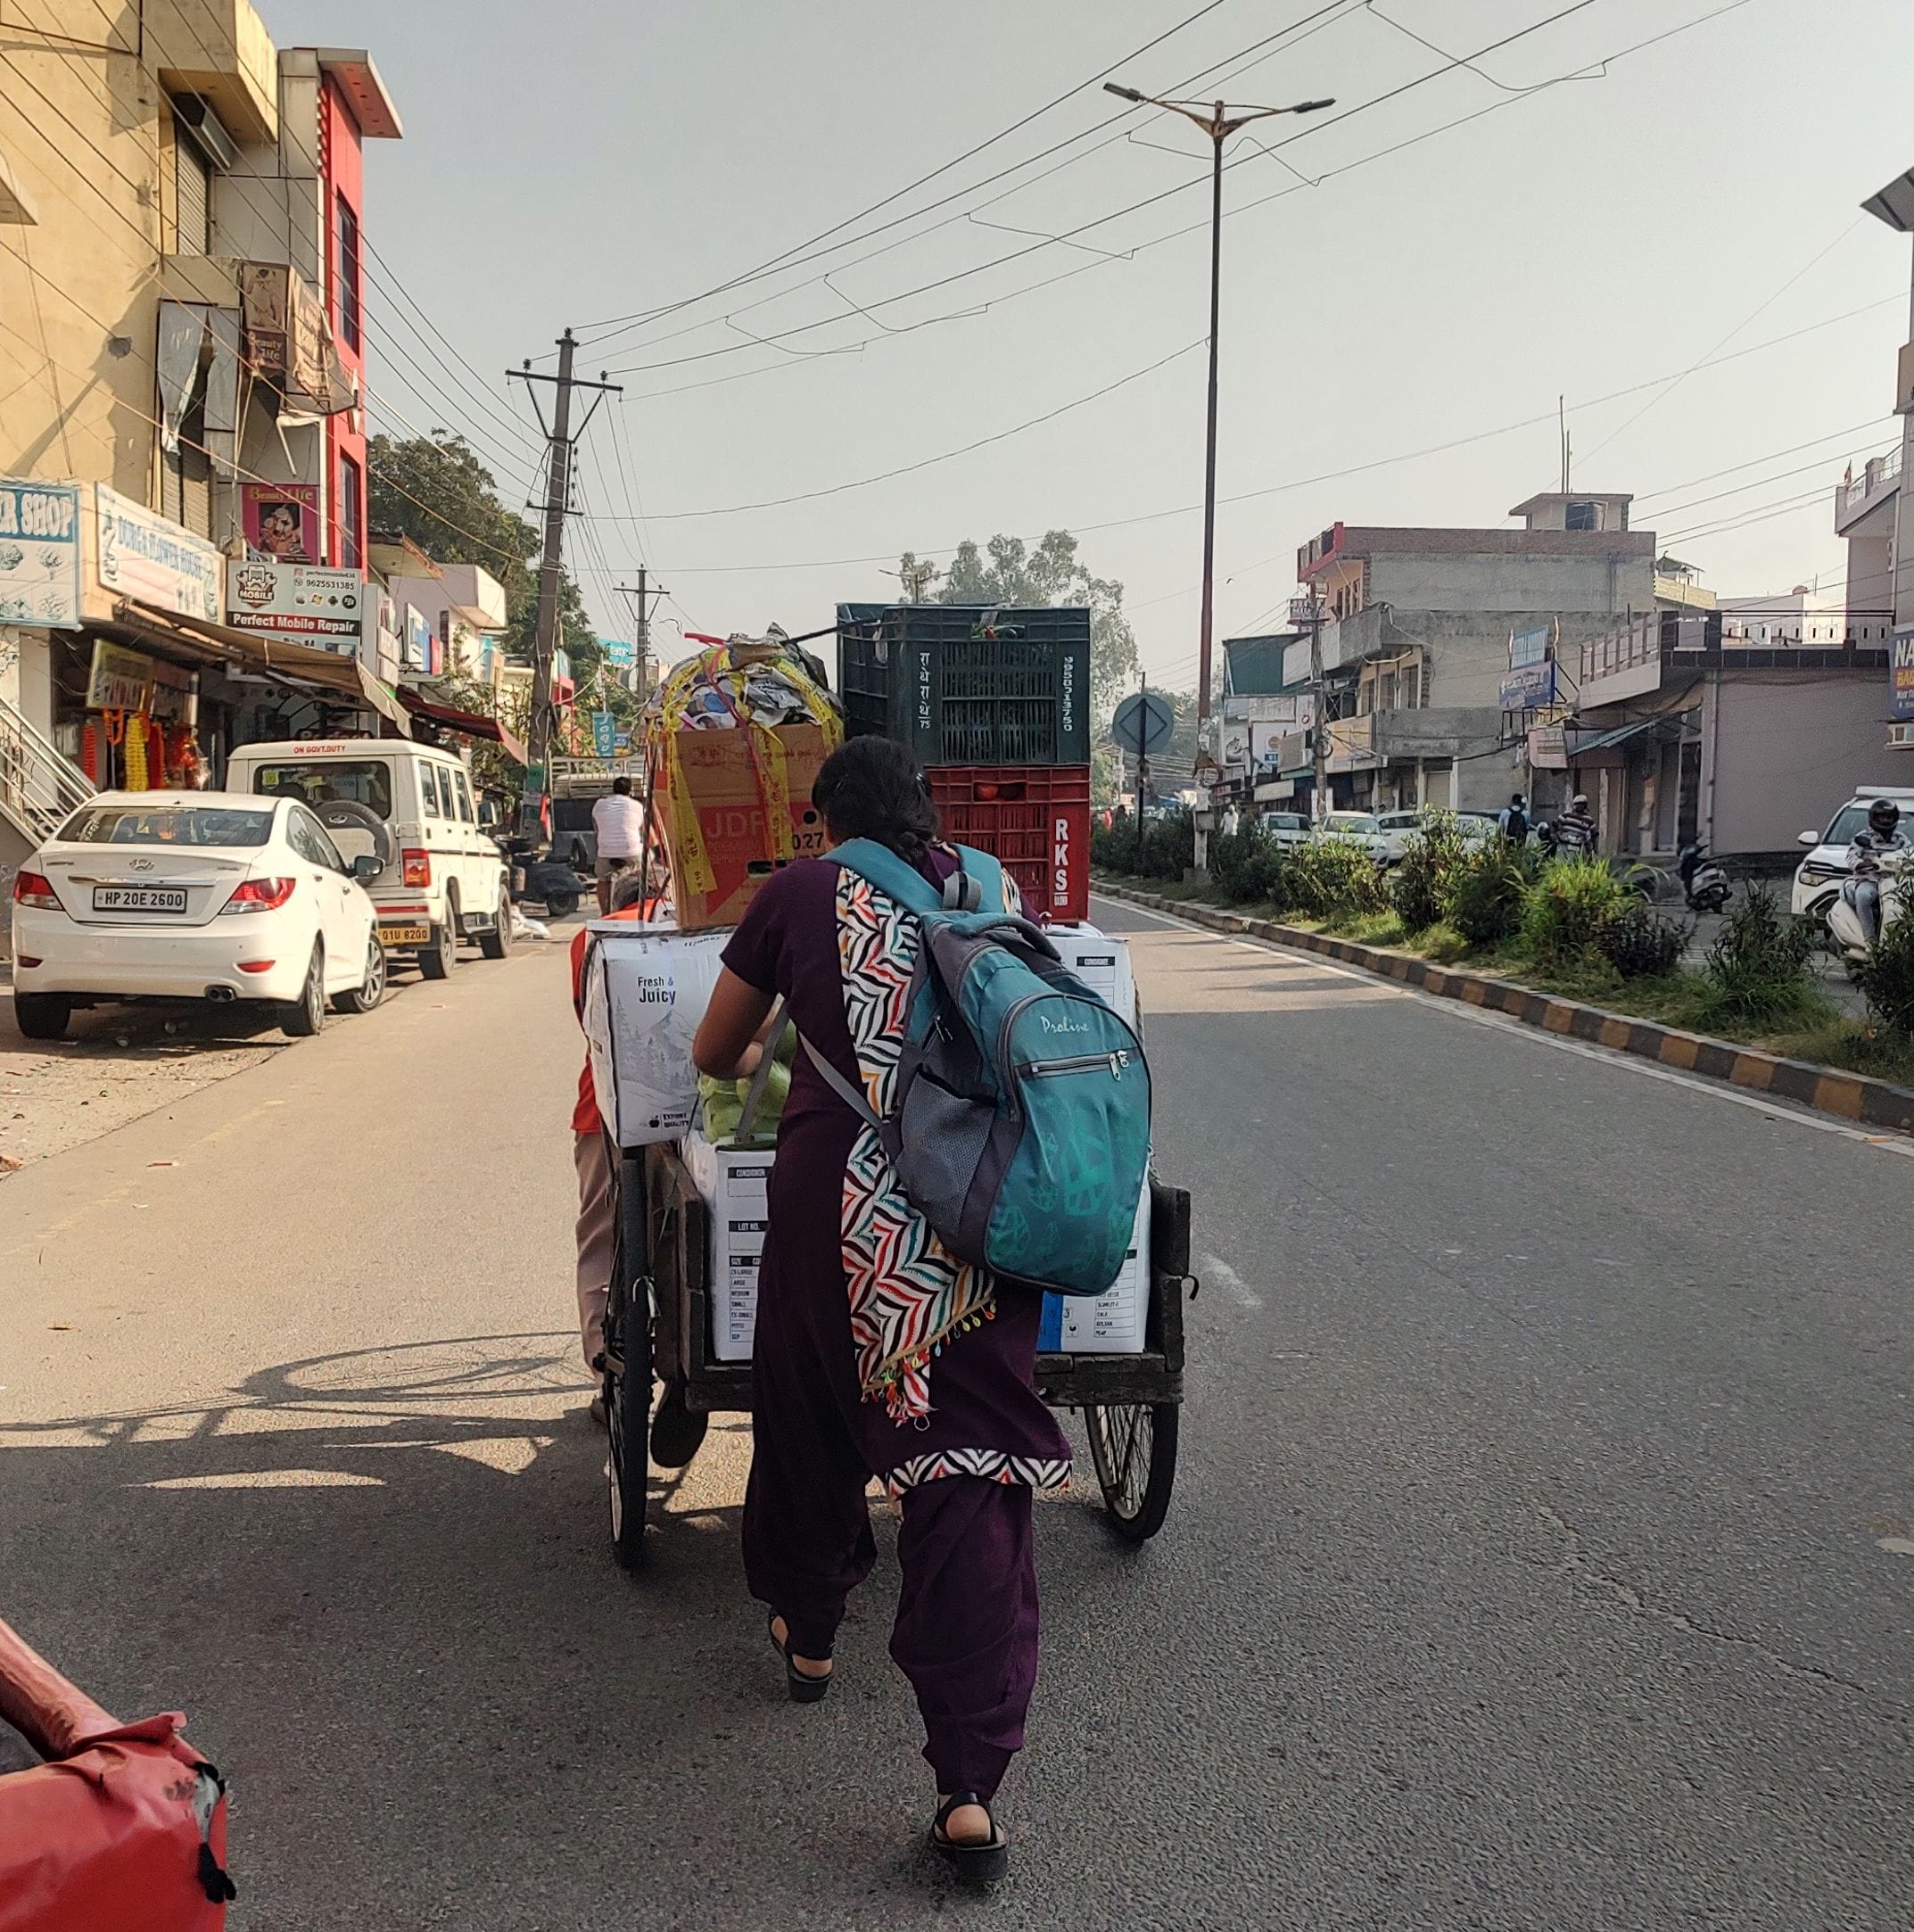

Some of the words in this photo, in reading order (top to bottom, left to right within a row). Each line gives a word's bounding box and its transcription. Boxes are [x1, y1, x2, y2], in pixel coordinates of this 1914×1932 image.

[21, 493, 72, 537] SHOP
[239, 590, 273, 599] MOBILE
[233, 613, 276, 626] Perfect
[277, 617, 315, 630] Mobile
[317, 620, 355, 633] Repair
[1054, 819, 1069, 891] RKS
[104, 892, 121, 904] HP
[123, 893, 147, 906] 20E
[150, 894, 183, 907] 2600
[404, 929, 428, 940] 8200
[638, 976, 664, 987] Fresh
[667, 976, 674, 987] &
[639, 987, 676, 1006] Juicy
[1040, 1015, 1090, 1033] Proline
[738, 1222, 749, 1231] LOT
[730, 1257, 743, 1266] SIZE
